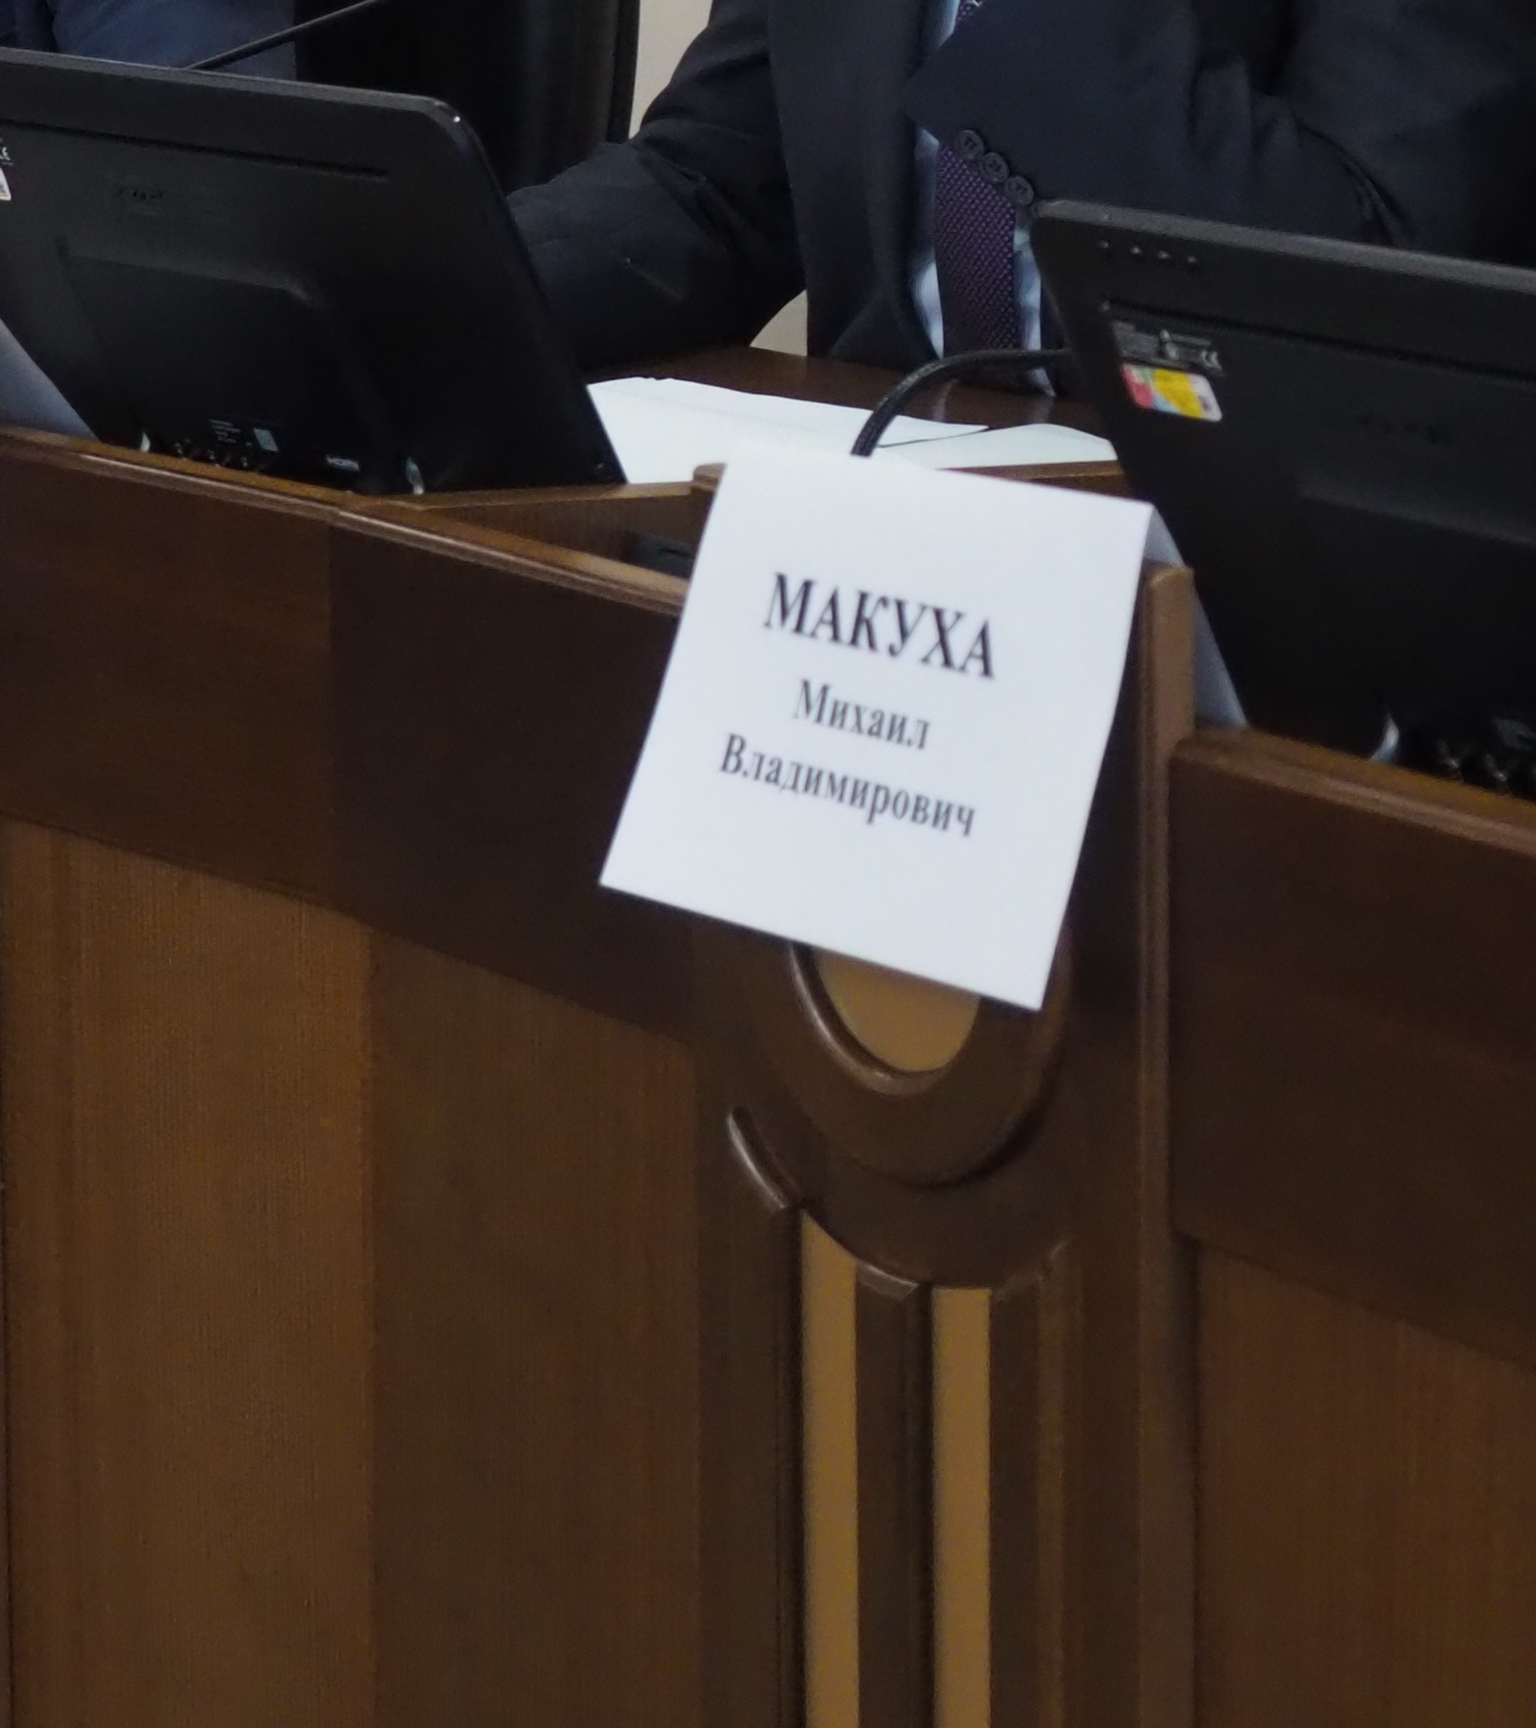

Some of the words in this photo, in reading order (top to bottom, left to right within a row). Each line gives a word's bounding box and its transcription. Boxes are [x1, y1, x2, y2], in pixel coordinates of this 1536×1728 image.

[764, 573, 995, 678] МАКУХА
[792, 679, 930, 750] Михаил
[719, 733, 975, 837] Владимирович
